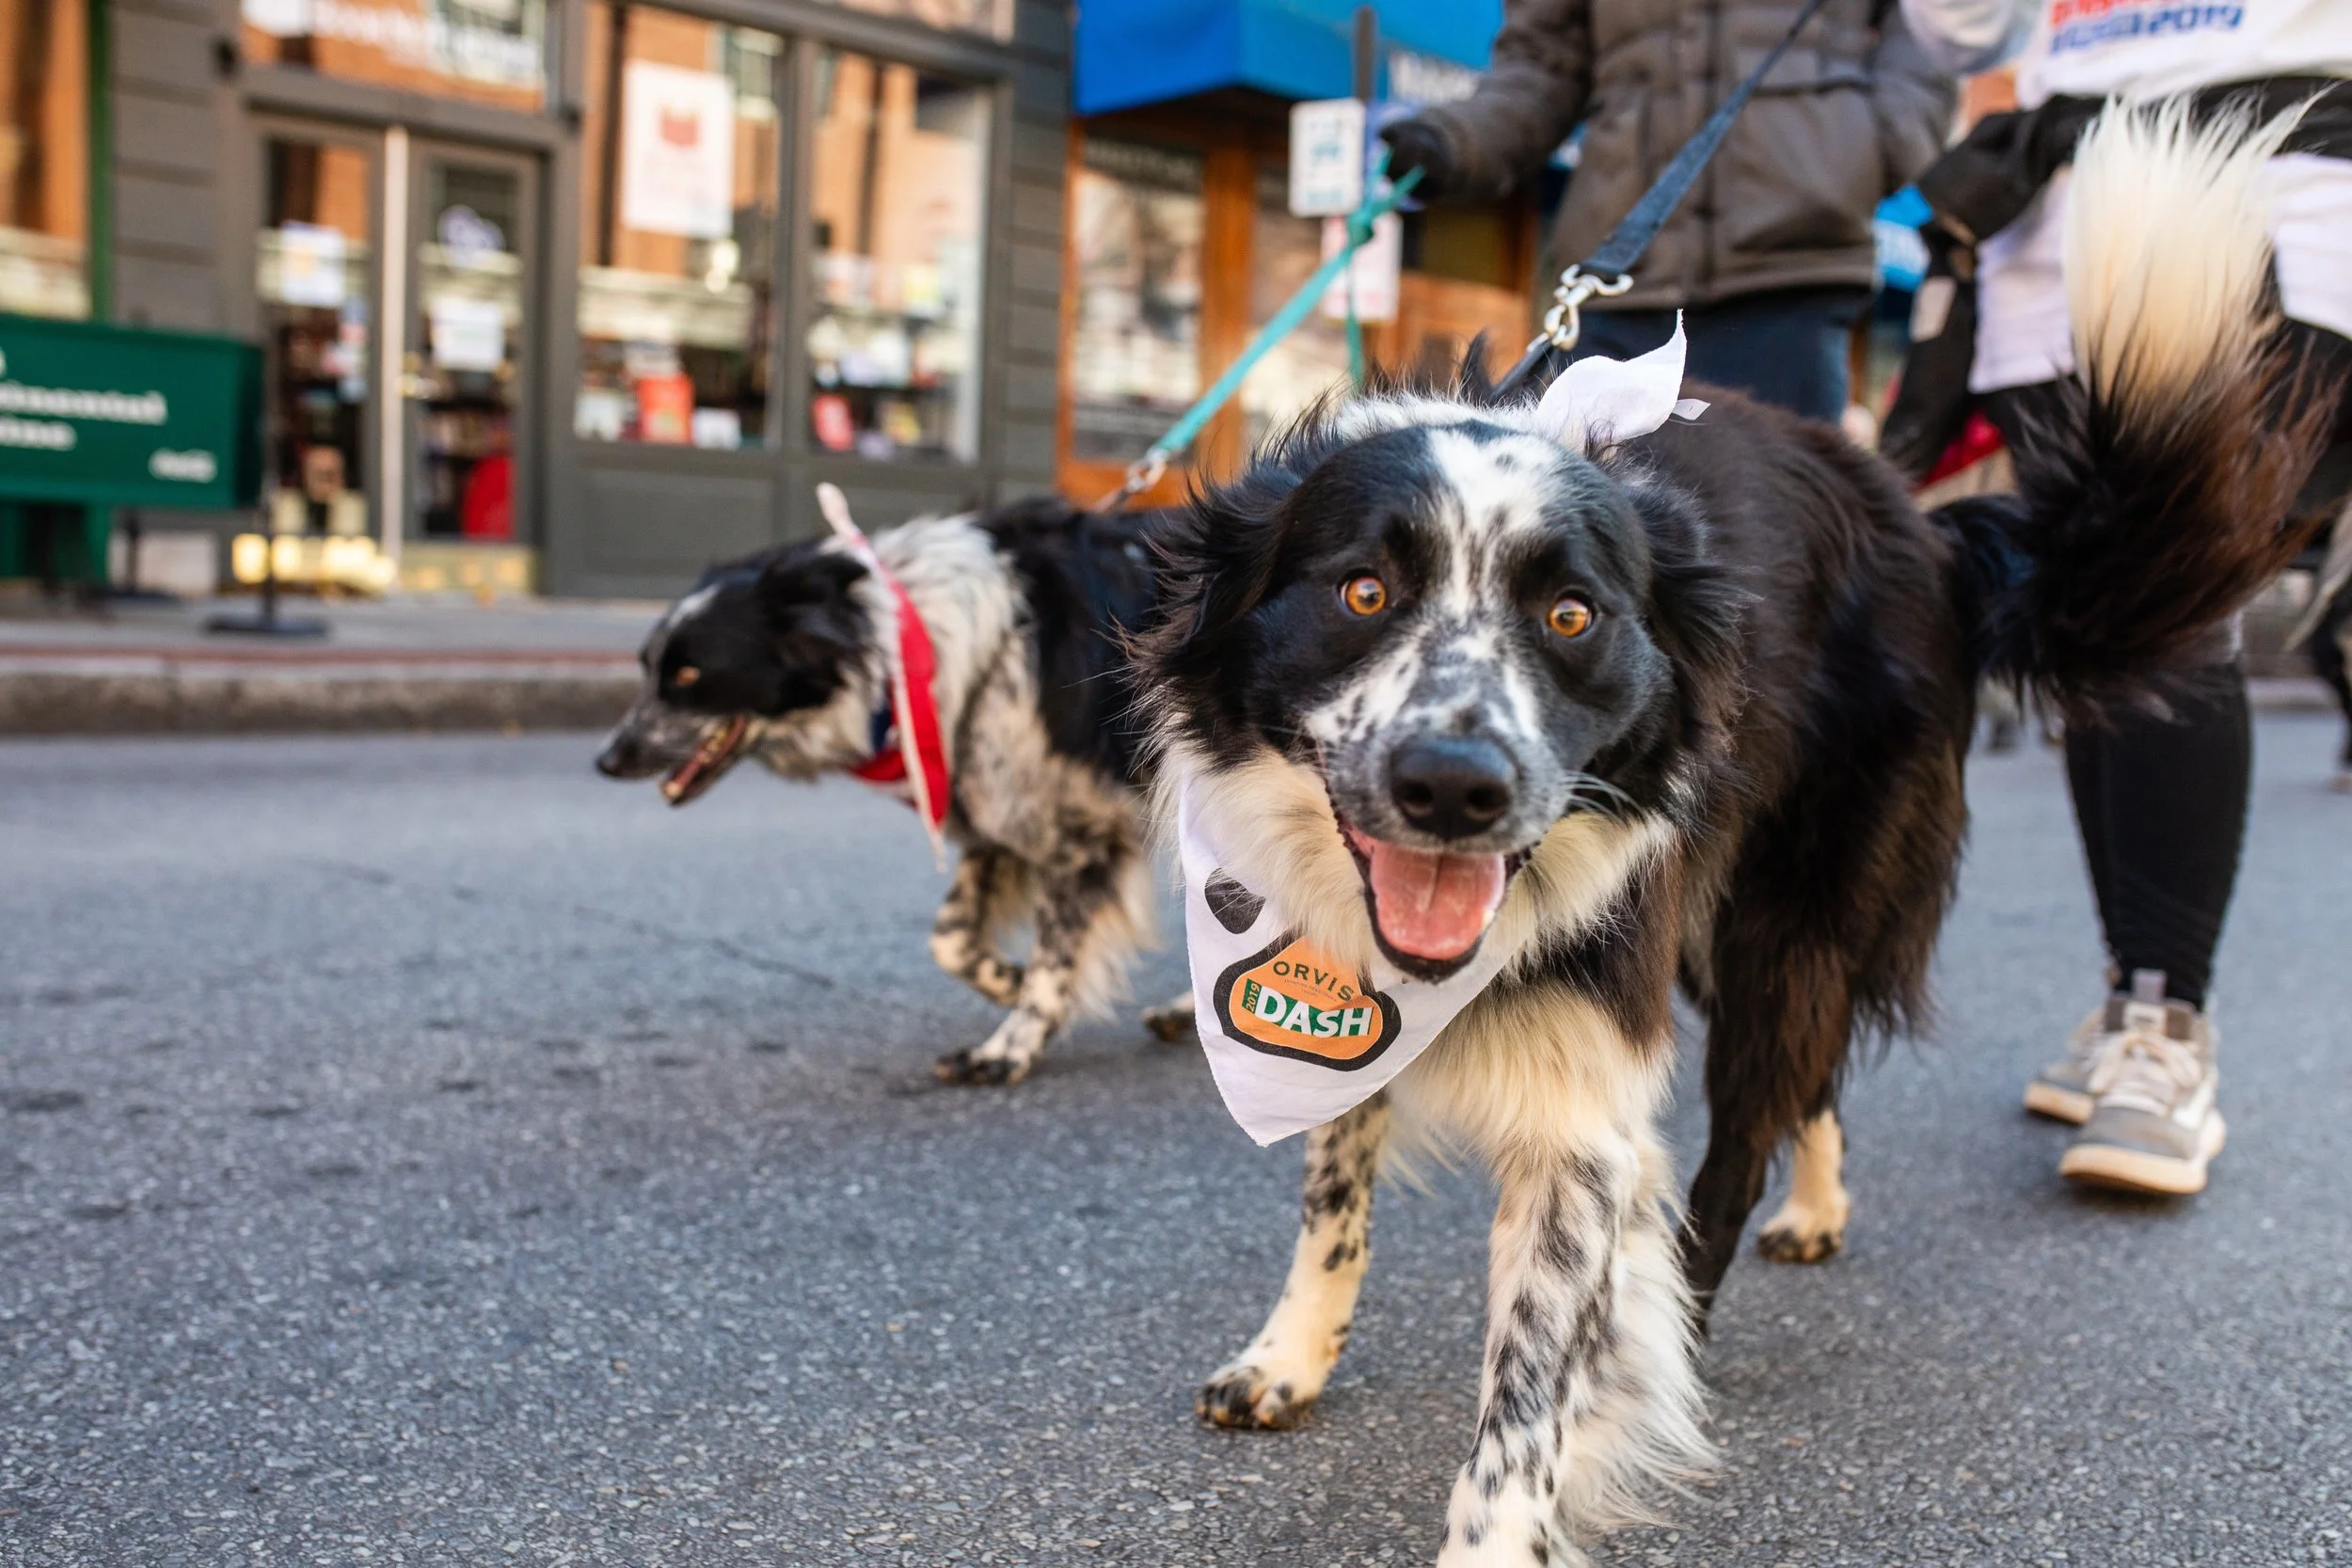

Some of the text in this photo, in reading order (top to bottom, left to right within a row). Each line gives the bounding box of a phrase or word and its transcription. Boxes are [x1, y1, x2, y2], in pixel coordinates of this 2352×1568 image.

[1245, 984, 1261, 1012] 2019
[1273, 960, 1355, 1002] ORVIS
[1255, 985, 1373, 1037] DASH
